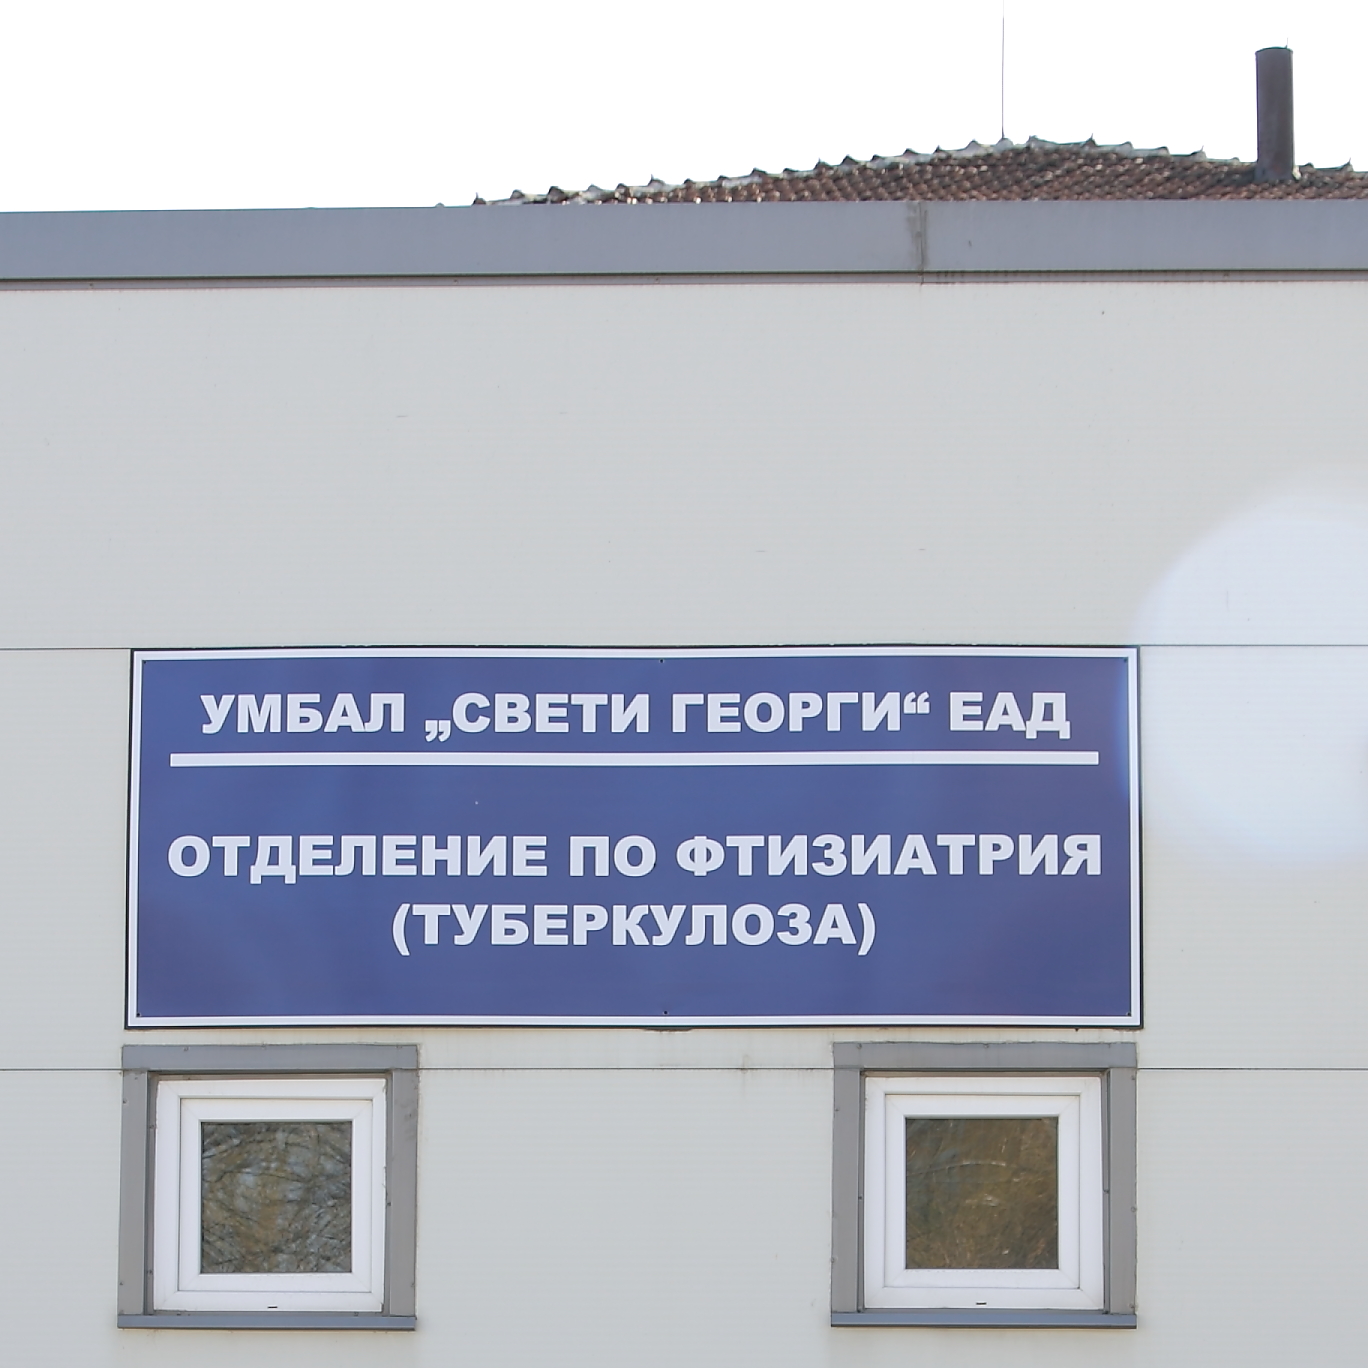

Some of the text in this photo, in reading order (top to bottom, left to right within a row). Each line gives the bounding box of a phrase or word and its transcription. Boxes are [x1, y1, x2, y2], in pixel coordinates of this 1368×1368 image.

[200, 691, 1072, 743] УМБАЛ „СВЕТИ ГЕОРГИ“ ЕАД
[166, 833, 1102, 885] ОТДЕЛЕНИЕ ПО ФТИЗИАТРИЯ
[391, 902, 877, 957] (ТУБЕРКУЛОЗА)
